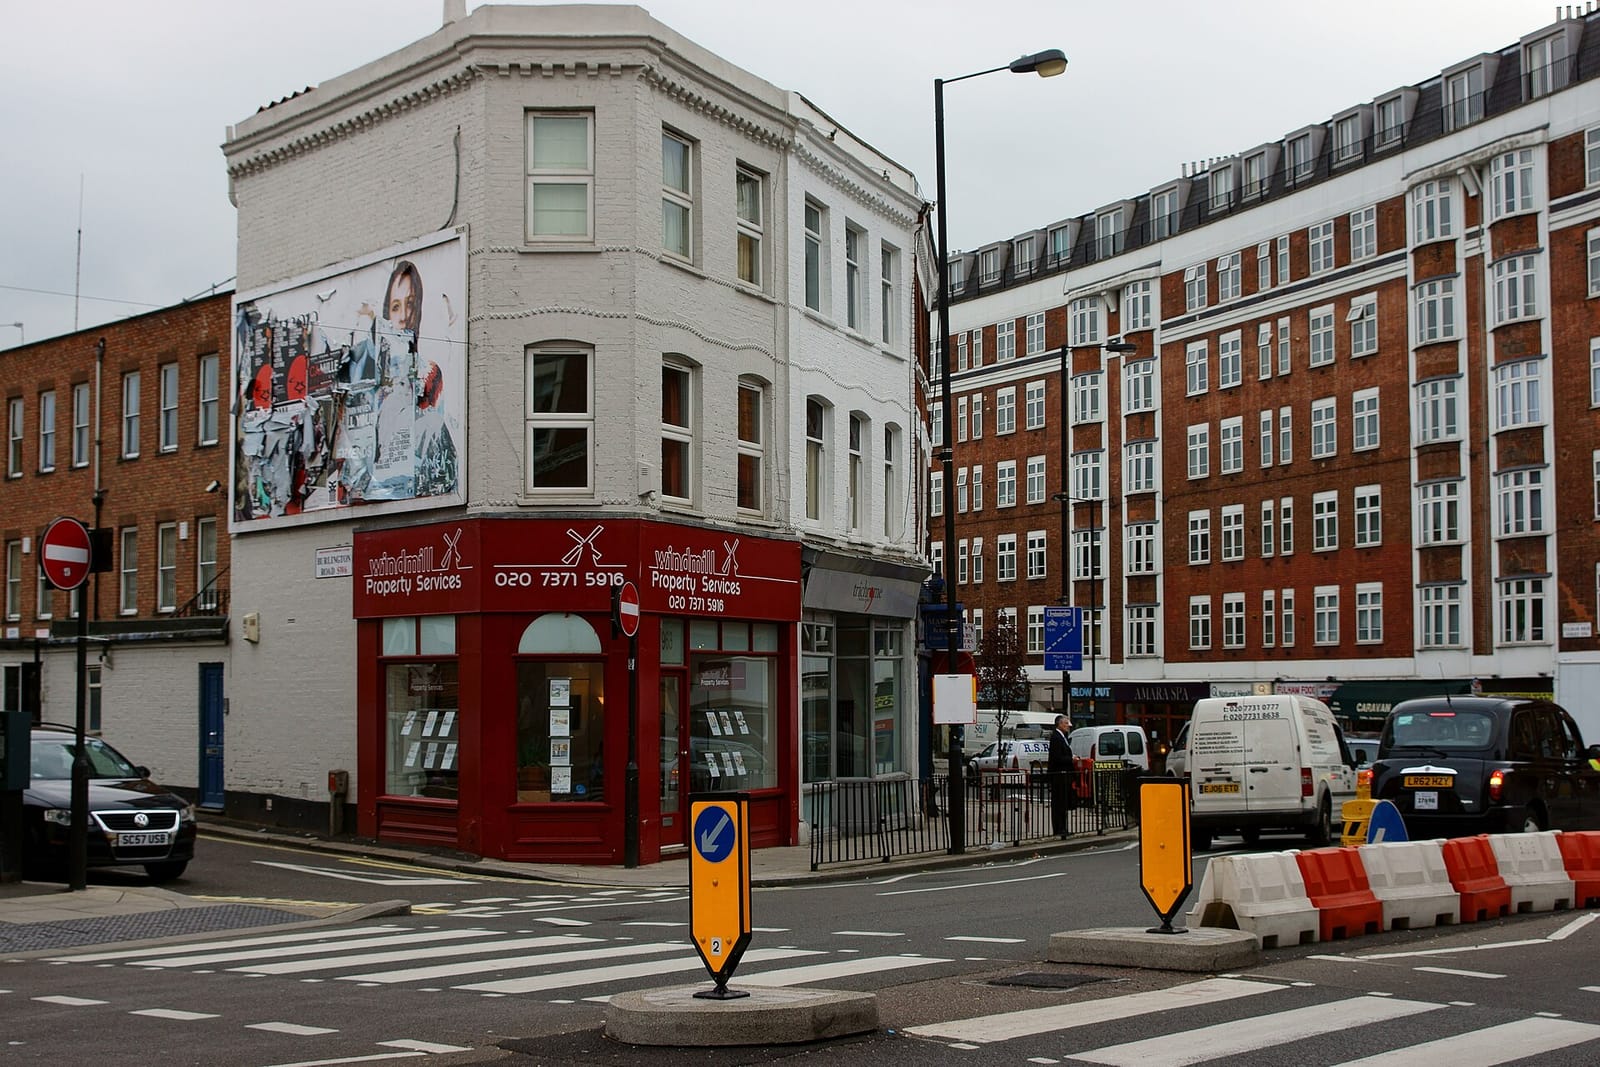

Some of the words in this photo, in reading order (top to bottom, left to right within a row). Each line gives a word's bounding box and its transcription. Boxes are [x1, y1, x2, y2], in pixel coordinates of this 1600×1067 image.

[317, 554, 351, 566] BURLINGTON
[369, 546, 434, 577] windmill
[655, 545, 716, 575] windmill
[320, 566, 335, 576] ROAD
[366, 576, 411, 597] Property
[416, 573, 462, 592] Services
[495, 572, 532, 587] 020
[540, 572, 577, 587] 7371
[585, 572, 625, 587] 5916
[652, 570, 696, 595] Property
[702, 576, 741, 596] Services
[668, 595, 686, 610] 020
[688, 596, 705, 611] 7371
[707, 598, 724, 612] 5916
[1071, 687, 1092, 697] BLOW
[1094, 687, 1111, 697] OUT
[1134, 687, 1169, 700] AMARA
[1170, 687, 1189, 700] SPA
[1243, 704, 1261, 712] 7731
[1262, 703, 1280, 711] 0777
[1243, 712, 1261, 720] 7731
[1407, 776, 1431, 786] LR62
[1431, 776, 1450, 785] HZY
[122, 835, 146, 845] SC57
[712, 941, 720, 953] 2
